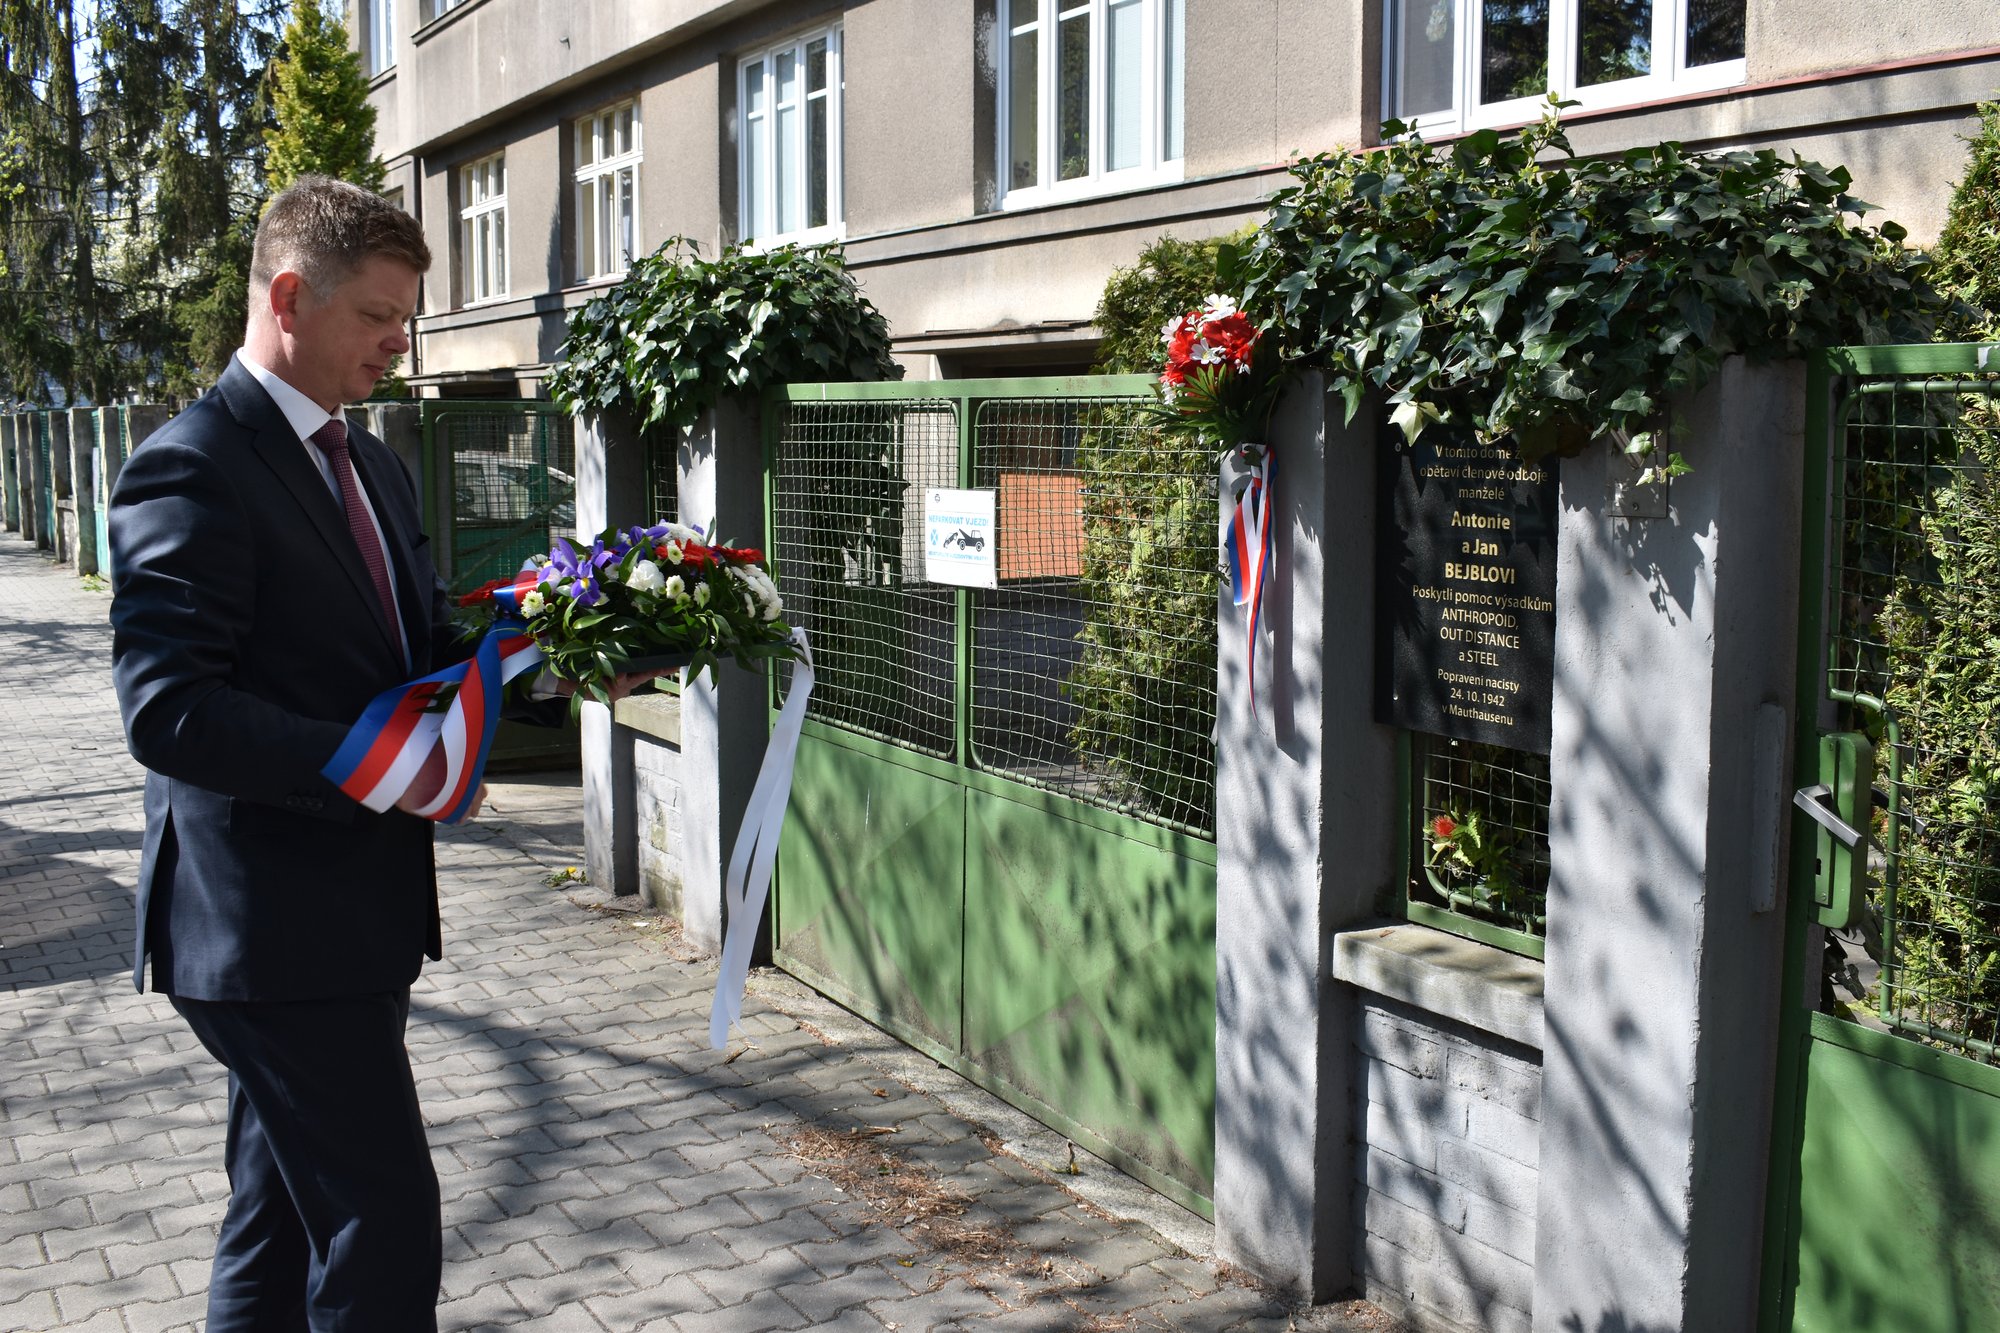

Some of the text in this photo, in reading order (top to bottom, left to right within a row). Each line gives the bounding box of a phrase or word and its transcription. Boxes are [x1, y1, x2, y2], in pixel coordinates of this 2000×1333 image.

[1435, 444, 1443, 458] V
[1445, 446, 1478, 459] tomto
[1419, 464, 1548, 485] obětaví členové odboje
[1458, 486, 1505, 501] manželé
[1451, 510, 1511, 530] Antonie
[1462, 538, 1499, 556] a Jan
[1444, 562, 1515, 585] BEJBLOVI
[1412, 584, 1553, 612] Poskytli pomoc výsadkům
[1441, 607, 1519, 630] ANTHROPOID,
[1439, 626, 1520, 649] OUT DISTANCE
[1458, 650, 1500, 667] a STEEL
[1437, 668, 1520, 694] Popraveni nacisty
[1450, 687, 1505, 707] 24. 10. 1942
[1442, 704, 1513, 726] v Mauthausenu
